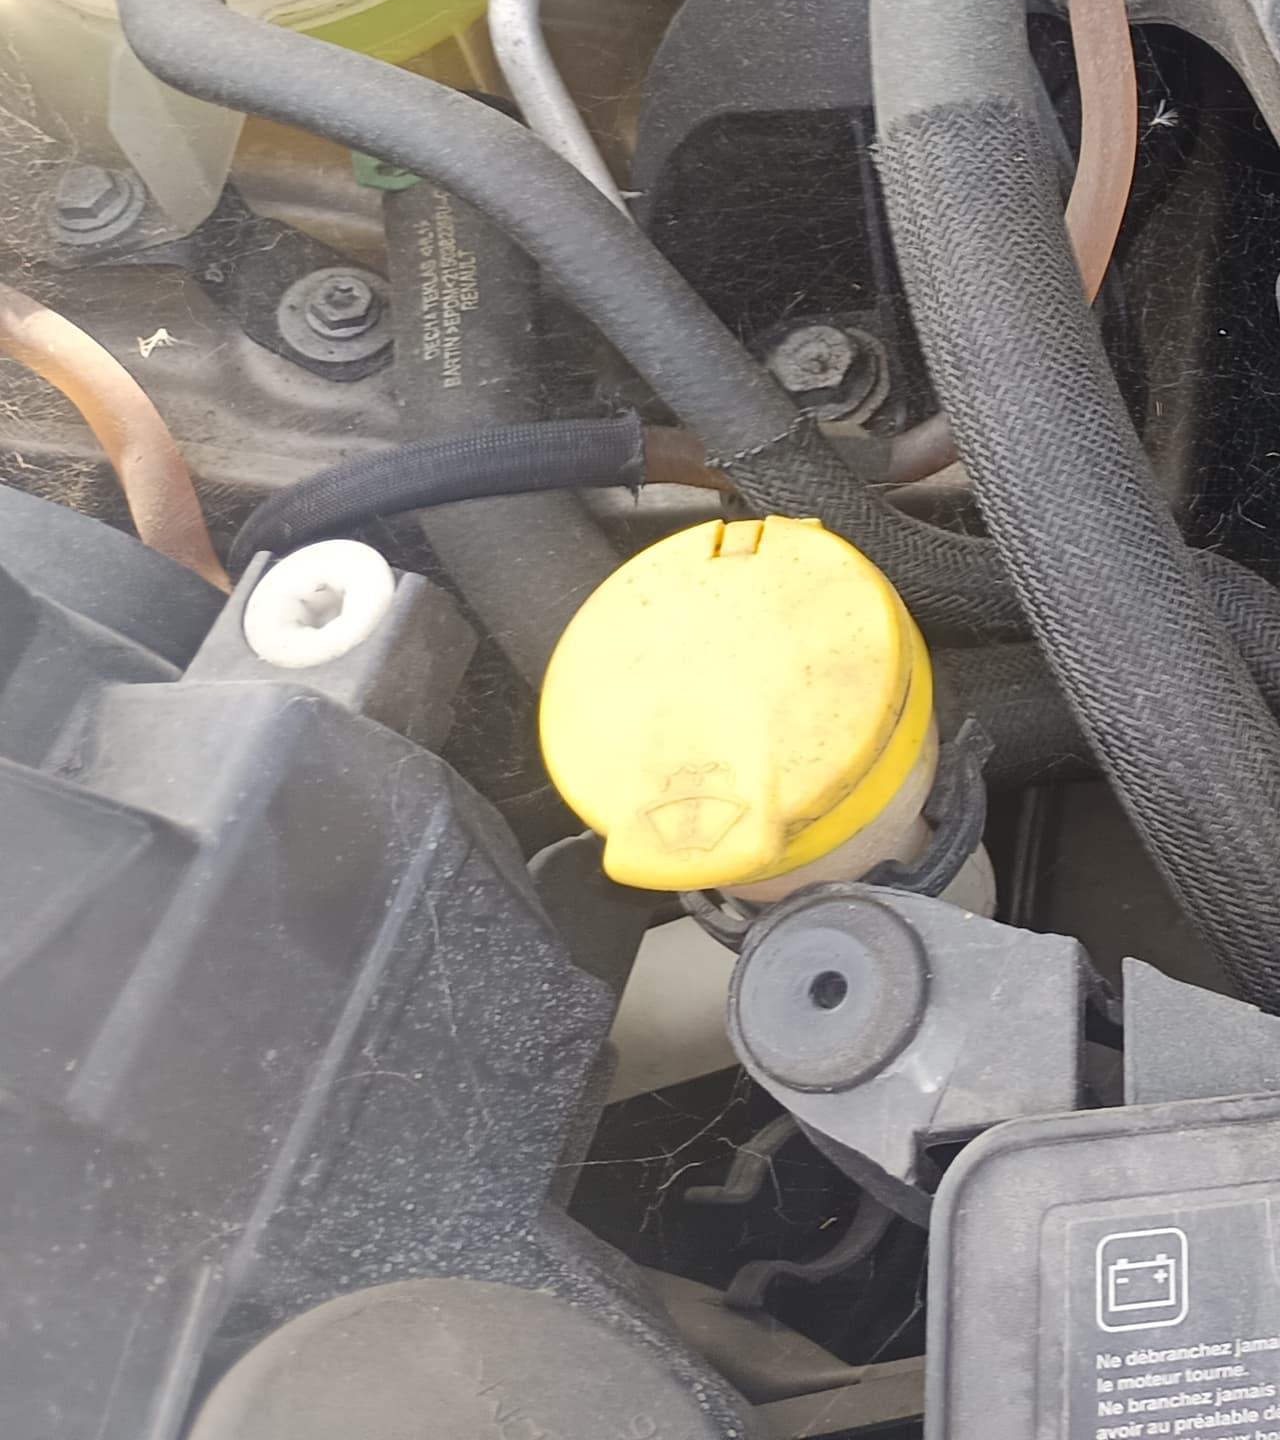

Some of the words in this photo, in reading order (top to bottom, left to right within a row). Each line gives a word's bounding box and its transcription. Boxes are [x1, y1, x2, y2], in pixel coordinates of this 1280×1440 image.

[460, 249, 480, 311] RENAULT
[1095, 1352, 1121, 1369] Ne
[1095, 1376, 1114, 1392] le
[1116, 1369, 1183, 1390] moteur
[1096, 1398, 1124, 1416] Ne
[1125, 1388, 1213, 1413] branchez
[1213, 1381, 1276, 1406] jamais
[1094, 1419, 1144, 1440] avoir
[1145, 1420, 1170, 1434] au
